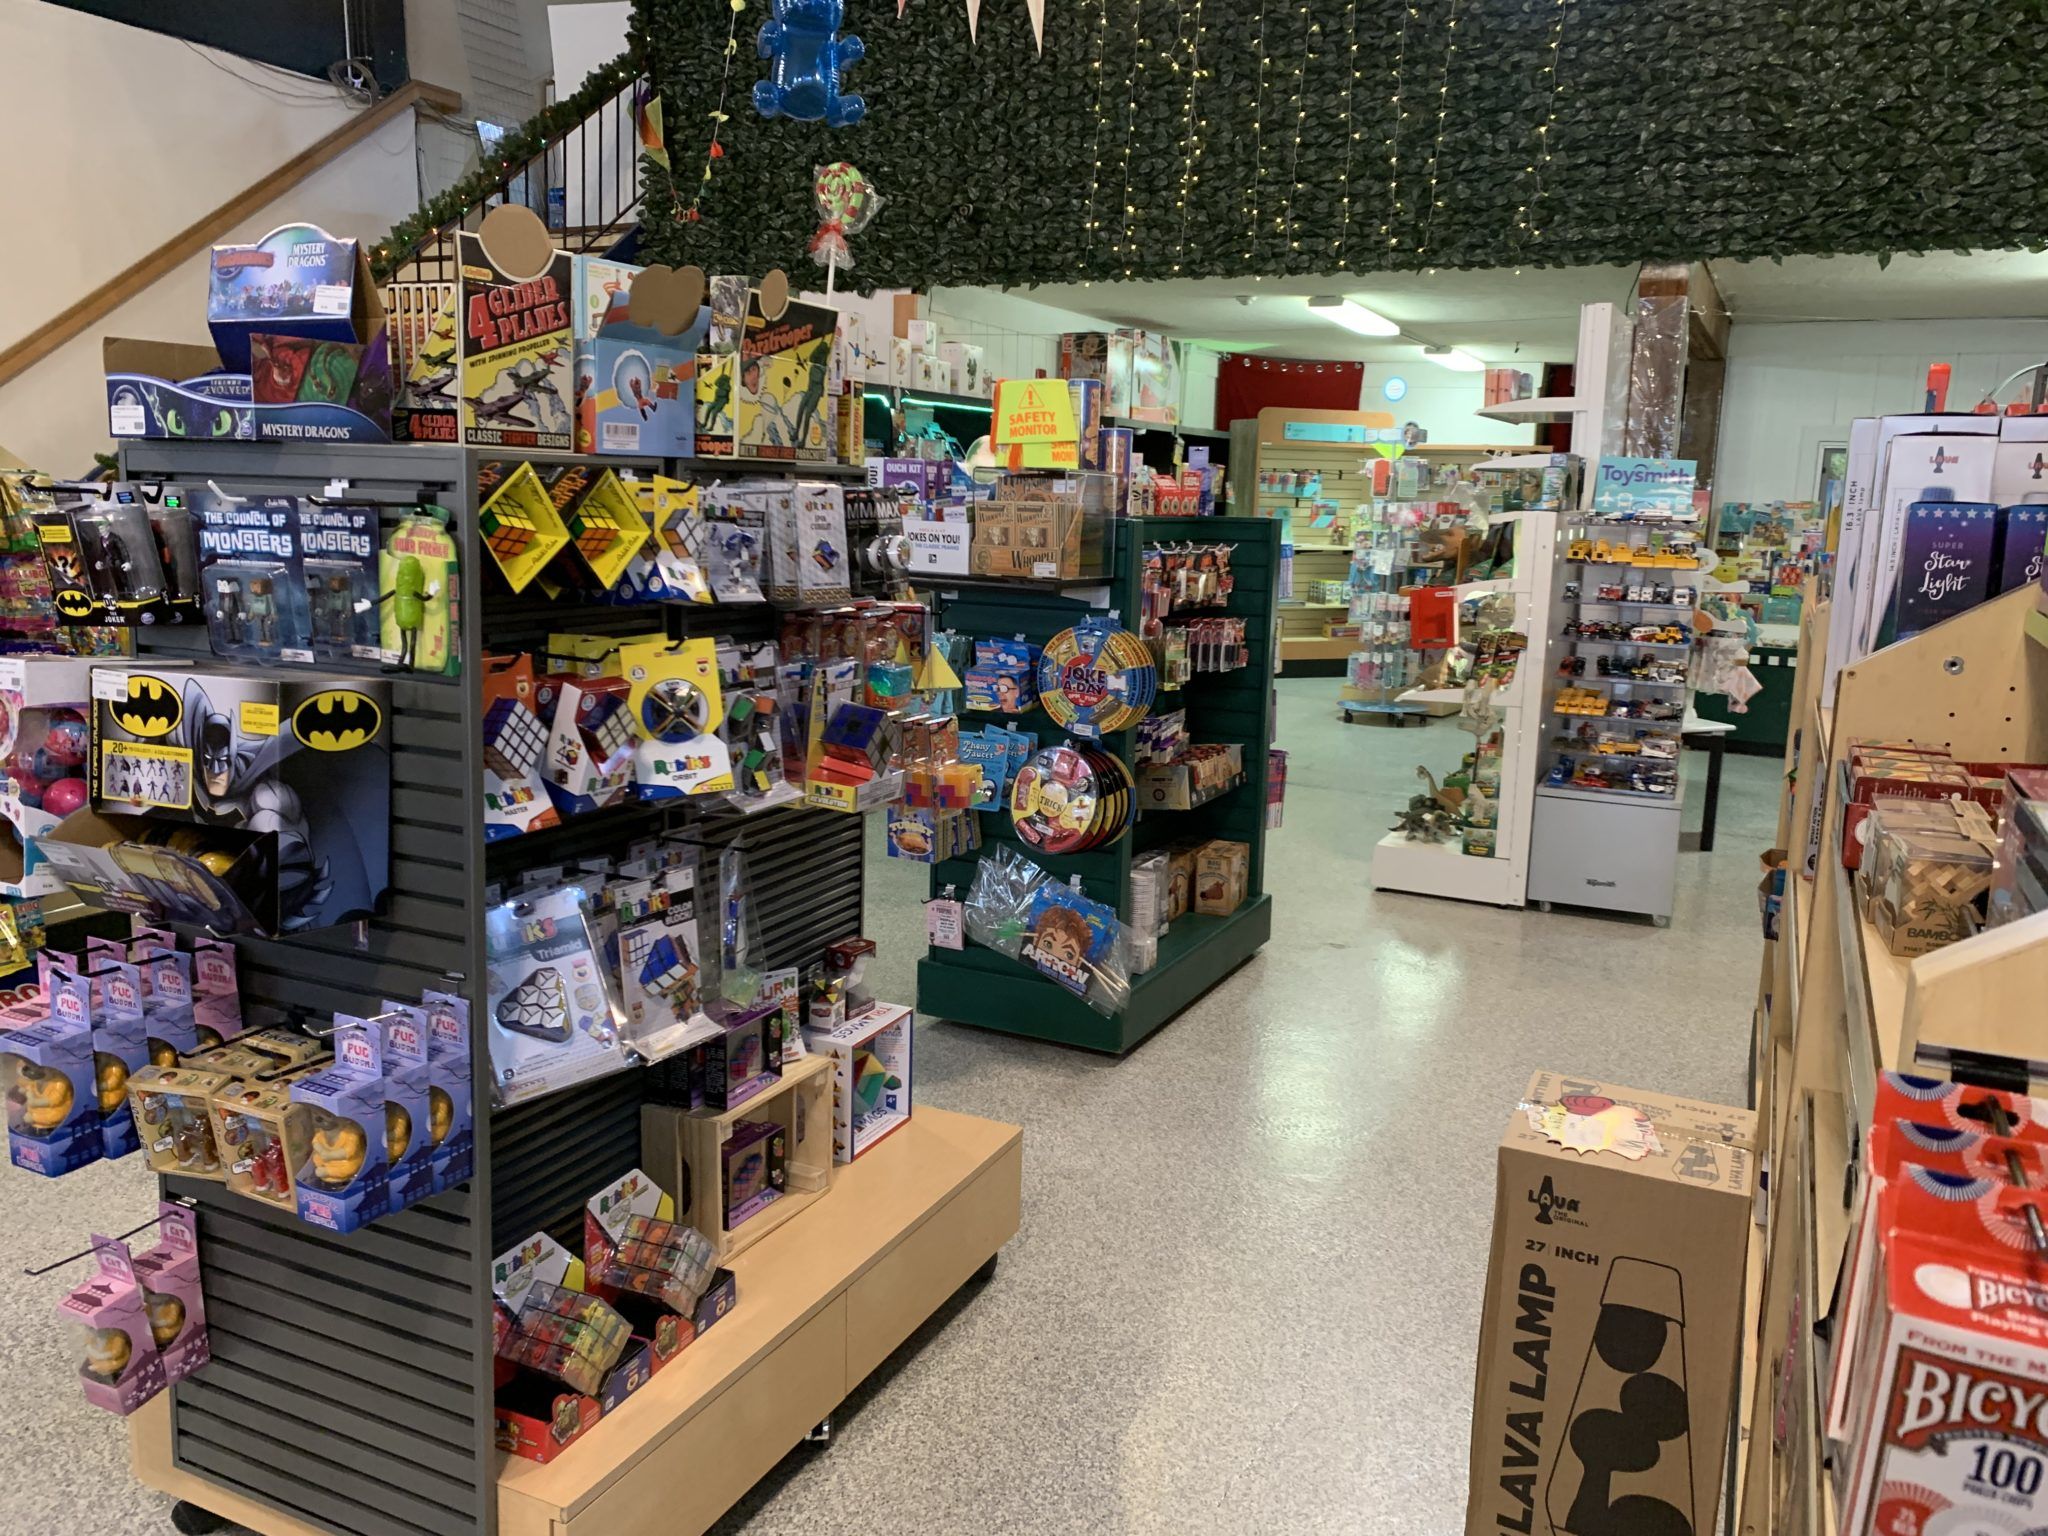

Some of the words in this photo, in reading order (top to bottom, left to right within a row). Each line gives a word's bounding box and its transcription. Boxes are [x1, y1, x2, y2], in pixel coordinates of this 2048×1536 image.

[292, 243, 326, 255] MYSTERY
[288, 254, 326, 267] DRAGONS
[468, 293, 499, 349] 4
[488, 276, 560, 316] GLIDER
[497, 302, 569, 344] PLANES
[469, 358, 487, 368] WITH
[518, 339, 551, 354] PROPELLER
[205, 386, 250, 395] EVOLVED
[409, 414, 422, 438] 4
[421, 414, 457, 428] GLIDER
[1009, 411, 1056, 426] SAFETY
[262, 423, 303, 437] MYSTERY
[305, 426, 351, 439] DRAGONS
[421, 427, 457, 441] PLANES
[467, 428, 503, 443] CLASSIC
[537, 432, 571, 447] DESIGNS
[1009, 424, 1057, 438] MONITOR
[886, 463, 907, 473] OUCH
[909, 464, 922, 474] KIT
[1602, 464, 1690, 486] Toysmith
[1848, 481, 1858, 505] INCH
[204, 512, 223, 524] THE
[225, 511, 270, 527] COUNCIL
[272, 514, 287, 527] OF
[313, 513, 351, 527] COUNCIL
[353, 516, 366, 528] OF
[1845, 512, 1854, 531] 16.3
[203, 530, 293, 557] MONSTERS
[928, 532, 940, 542] ON
[942, 534, 960, 544] YOU!
[1924, 551, 1972, 571] Star
[1918, 571, 1971, 600] Light
[1065, 667, 1106, 684] JOKE
[112, 742, 128, 754] 20+
[962, 740, 991, 752] Phony
[963, 748, 995, 759] Faucet
[672, 773, 698, 782] ORBIT
[504, 807, 528, 816] MASTER
[1040, 796, 1064, 812] TRICK
[1907, 928, 1960, 941] BAMBO
[207, 963, 224, 975] CAT
[162, 973, 181, 986] PUG
[112, 985, 131, 999] PUG
[60, 997, 80, 1012] PUG
[436, 1018, 457, 1033] PUG
[394, 1028, 416, 1044] PUG
[347, 1042, 369, 1058] PUG
[1553, 1214, 1589, 1228] ORIGINAL
[169, 1223, 185, 1238] CAT
[1525, 1239, 1546, 1253] 27
[1554, 1245, 1599, 1267] INCH
[1978, 1278, 2048, 1313] BICYC
[1508, 1262, 1556, 1402] LAMP
[1908, 1330, 1968, 1356] FROM
[1976, 1349, 2016, 1367] THE
[1896, 1360, 2048, 1438] BICY
[1496, 1409, 1544, 1535] LAVA
[1967, 1444, 2044, 1496] 100
[1963, 1482, 1997, 1499] POKER
[2001, 1493, 2034, 1511] CHIPS
